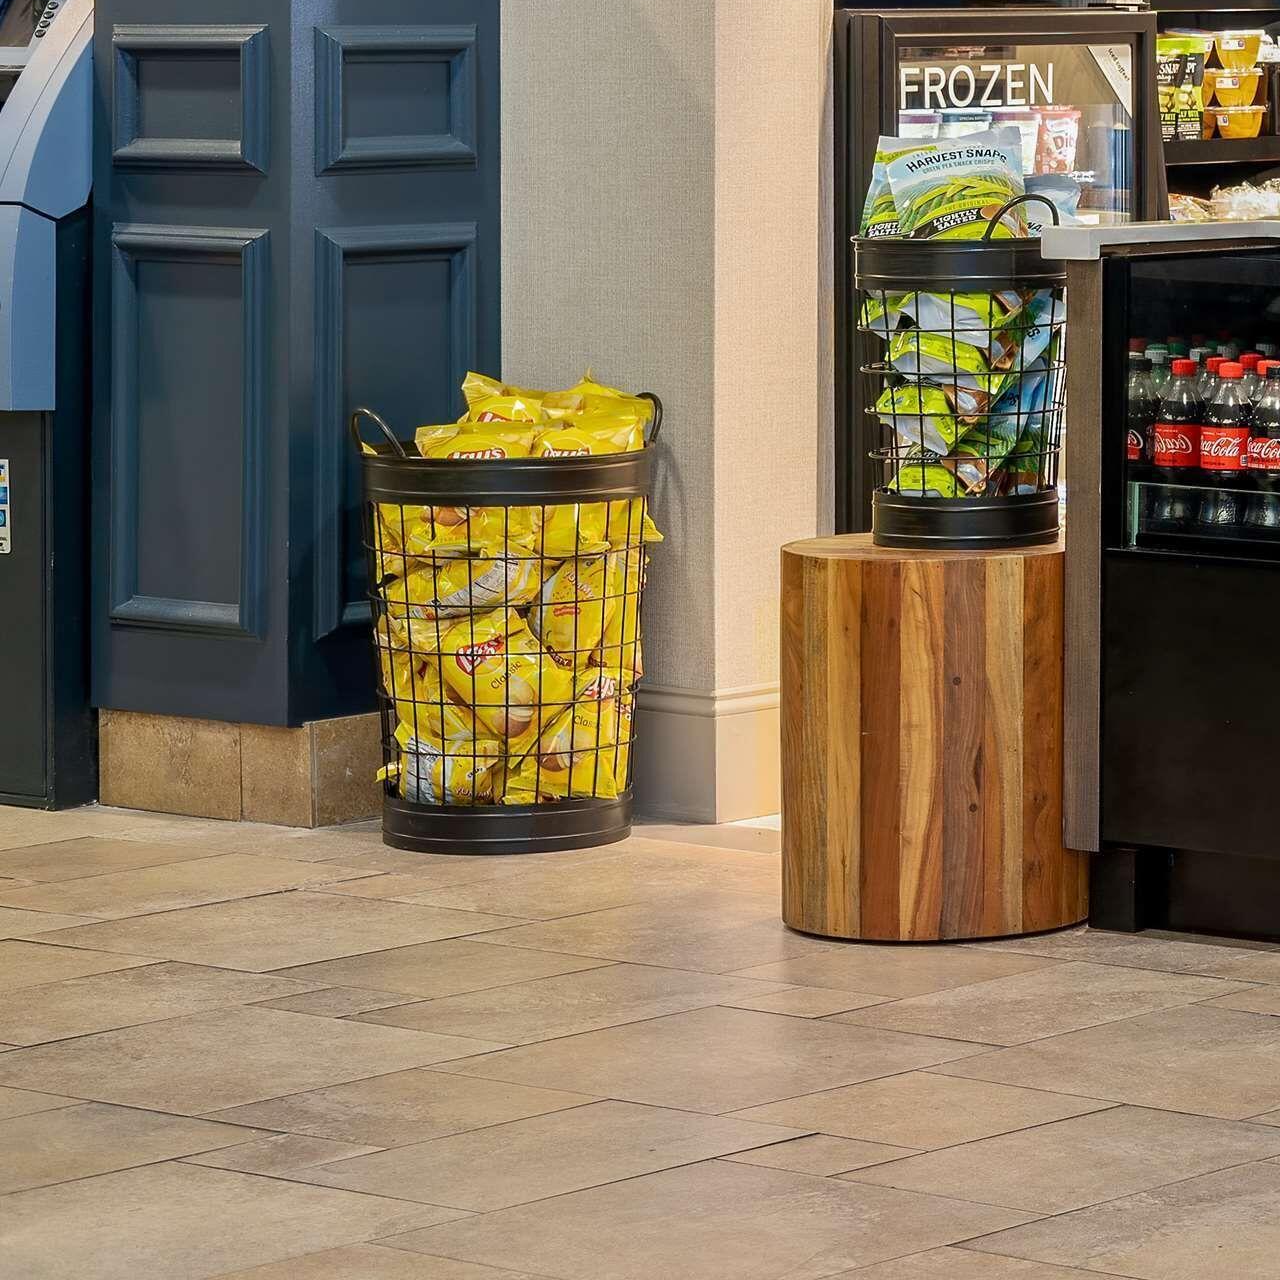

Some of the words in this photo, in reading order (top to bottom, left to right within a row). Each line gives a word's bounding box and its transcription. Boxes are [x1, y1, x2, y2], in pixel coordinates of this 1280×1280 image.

[900, 63, 1054, 109] FROZEN
[906, 150, 962, 172] HARVEST
[966, 149, 1007, 164] SNAPS
[933, 209, 978, 226] LIGHTLY
[936, 214, 978, 232] SALTED
